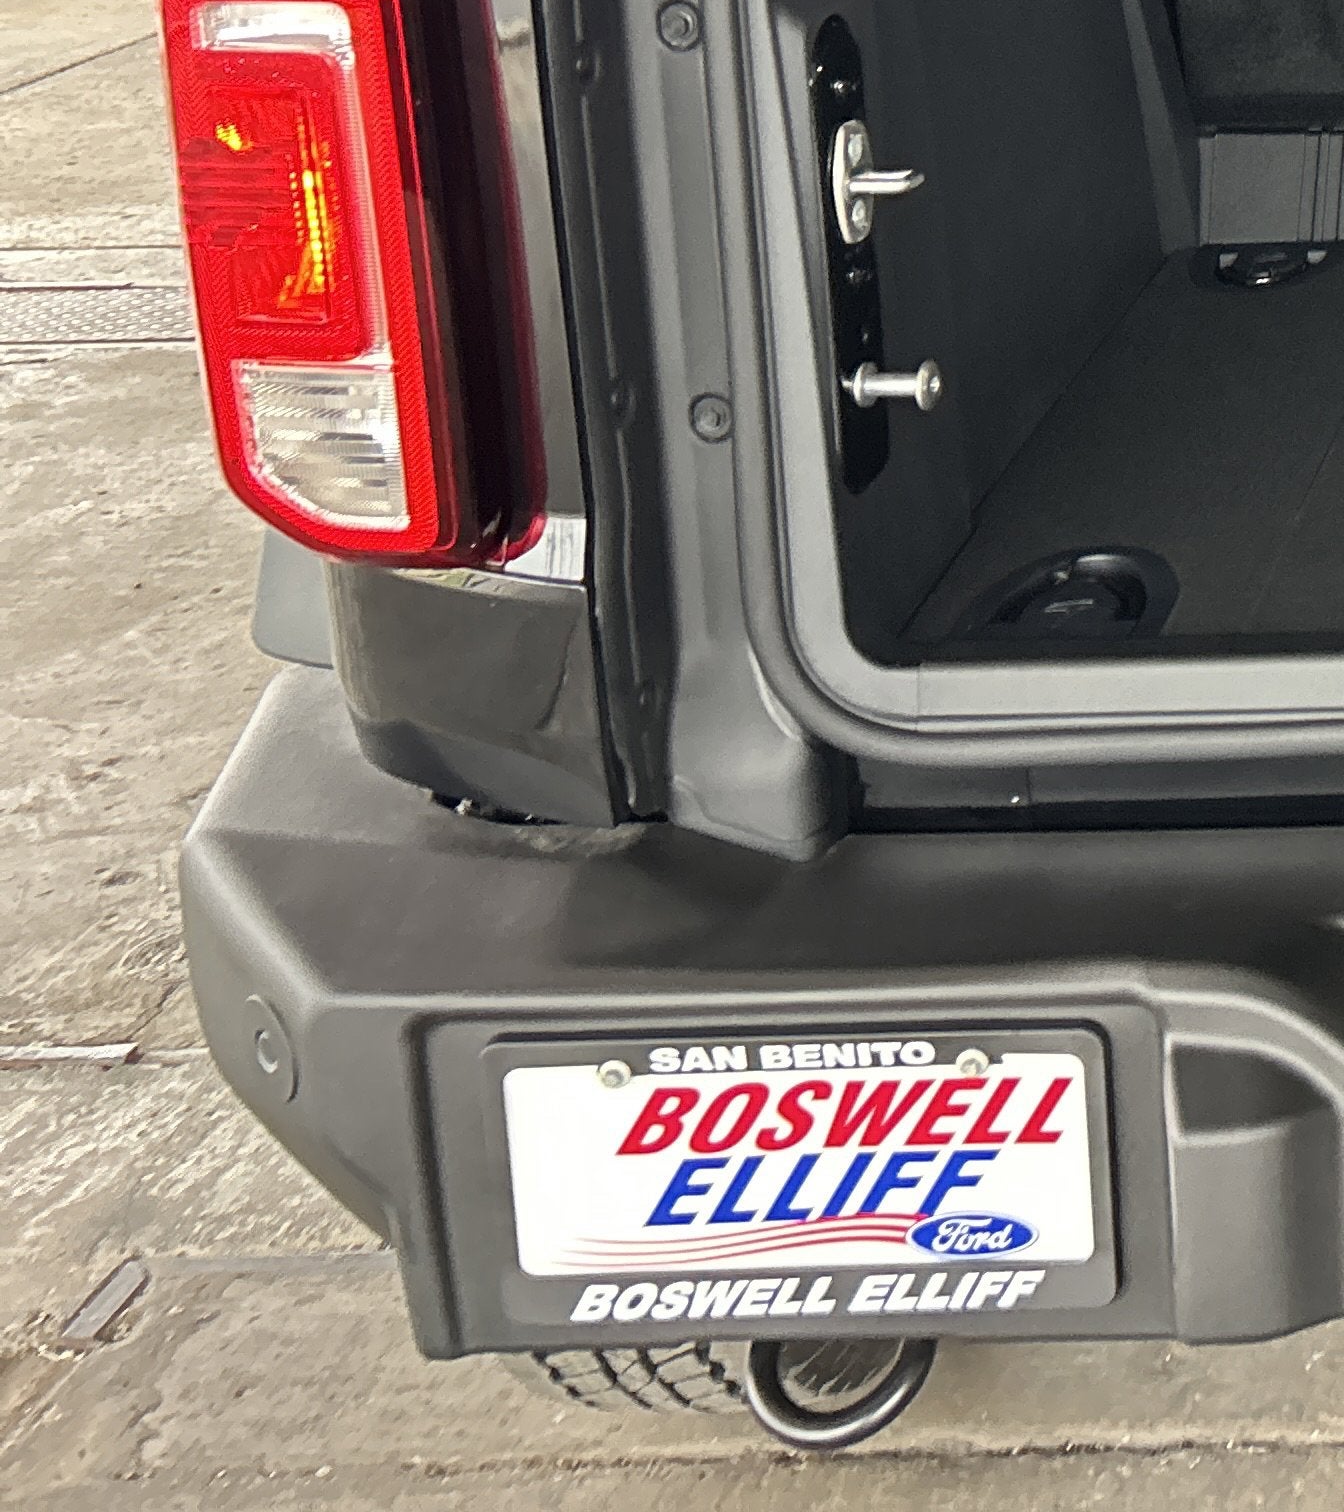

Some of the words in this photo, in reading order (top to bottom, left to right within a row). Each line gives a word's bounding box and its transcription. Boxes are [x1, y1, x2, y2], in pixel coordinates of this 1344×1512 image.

[649, 1045, 749, 1073] SAN
[759, 1040, 936, 1071] BENITO
[617, 1076, 1073, 1156] BOSWELL
[646, 1150, 1000, 1227] ELLIFF
[931, 1218, 1013, 1252] Ford
[569, 1275, 838, 1323] BOSWELL
[847, 1269, 1047, 1316] ELLIFF
